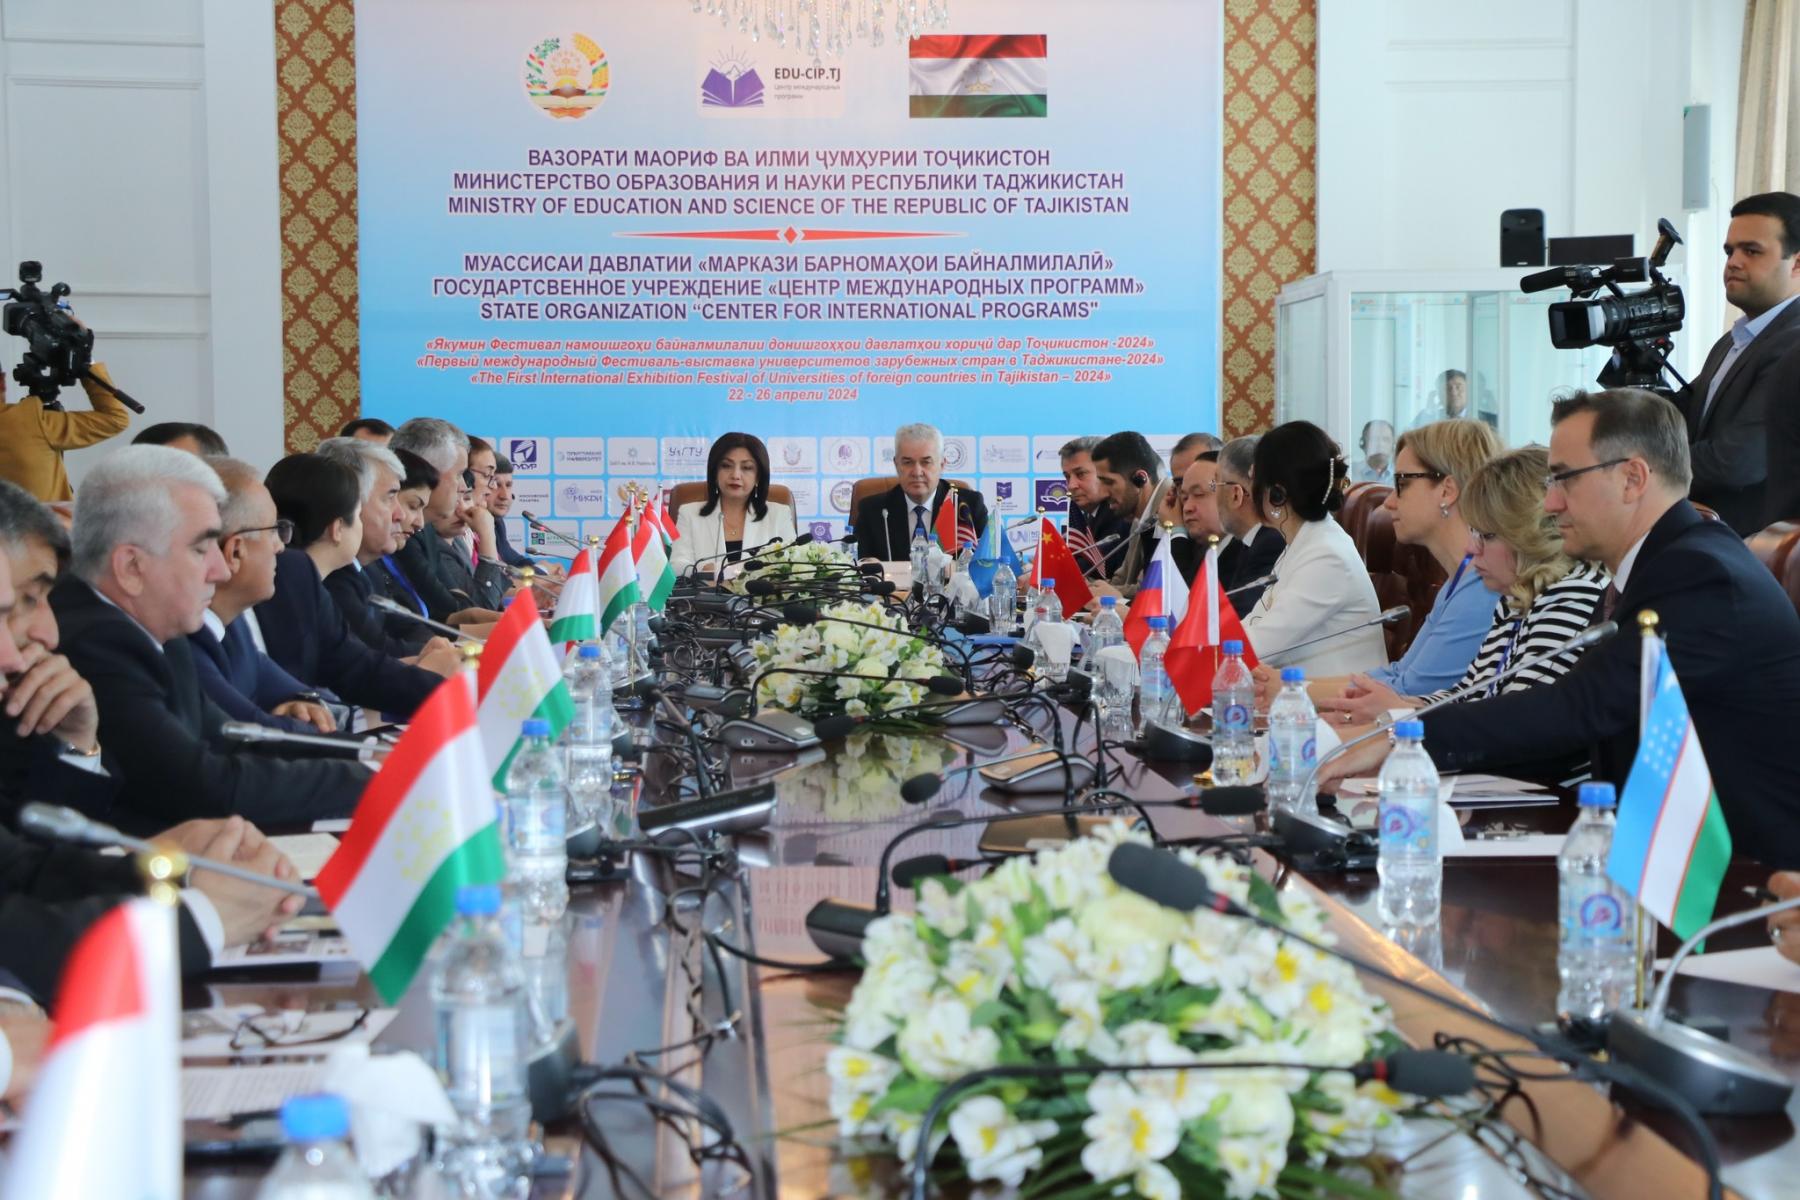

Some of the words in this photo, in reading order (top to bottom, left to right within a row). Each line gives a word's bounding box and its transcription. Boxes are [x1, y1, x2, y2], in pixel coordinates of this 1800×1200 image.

[775, 68, 841, 82] EDU-CIP.TJ
[528, 149, 628, 166] ВАЗОРАТИ
[634, 150, 718, 167] МАОРИФ
[724, 150, 749, 167] ВА
[755, 150, 809, 167] ИЛМИ
[454, 172, 611, 190] МИНИСТЕРСТВО
[616, 173, 759, 191] ОБРАЗОВАНИЯ
[766, 174, 778, 190] И
[784, 174, 845, 191] НАУКИ
[852, 174, 977, 190] РЕСПУБЛИКИ
[983, 173, 1123, 193] ТАДЖИКИСТАН
[448, 196, 537, 214] MINISTRY
[542, 197, 567, 214] OF
[574, 197, 682, 214] EDUCATION
[687, 198, 727, 214] AND
[733, 198, 814, 215] SCIENCE
[821, 198, 845, 214] OF
[851, 198, 887, 214] THE
[894, 197, 987, 214] REPUBLIC
[993, 197, 1018, 214] OF
[1023, 197, 1128, 213] TAJIKISTAN
[464, 255, 583, 272] МУАССИСАИ
[588, 255, 692, 275] ДАВЛАТИИ
[698, 255, 798, 272] «МАРКАЗИ
[434, 278, 626, 299] ГОСУДАРТСВЕННОЕ
[631, 279, 762, 299] УЧРЕЖДЕНИЕ
[768, 279, 840, 299] «ЦЕНТР
[846, 278, 1024, 298] МЕЖДУНАРОДНЫХ
[1030, 278, 1144, 295] ПРОГРАММ»
[481, 302, 539, 319] STATE
[544, 302, 687, 320] ORGANIZATION
[783, 303, 822, 320] FOR
[828, 302, 976, 319] INTERNATIONAL
[490, 338, 561, 351] Фестивал
[997, 338, 1022, 351] дар
[483, 355, 597, 368] международный
[601, 355, 755, 367] Фестиваль-выставка
[759, 358, 870, 368] университетов
[875, 355, 957, 369] зарубежных
[962, 357, 1005, 368] стран
[1009, 357, 1017, 366] в
[507, 371, 537, 384] First
[540, 372, 624, 384] International
[627, 372, 693, 384] Exhibition
[697, 371, 748, 384] Festival
[752, 371, 765, 384] of
[770, 373, 845, 384] Universities
[849, 370, 863, 383] of
[866, 371, 912, 386] foreign
[916, 373, 977, 383] countries
[981, 371, 993, 382] in
[998, 370, 1059, 385] Tajikistan
[728, 388, 744, 401] 22
[756, 388, 771, 401] 26
[775, 390, 823, 403] апрели
[828, 388, 858, 401] 2024
